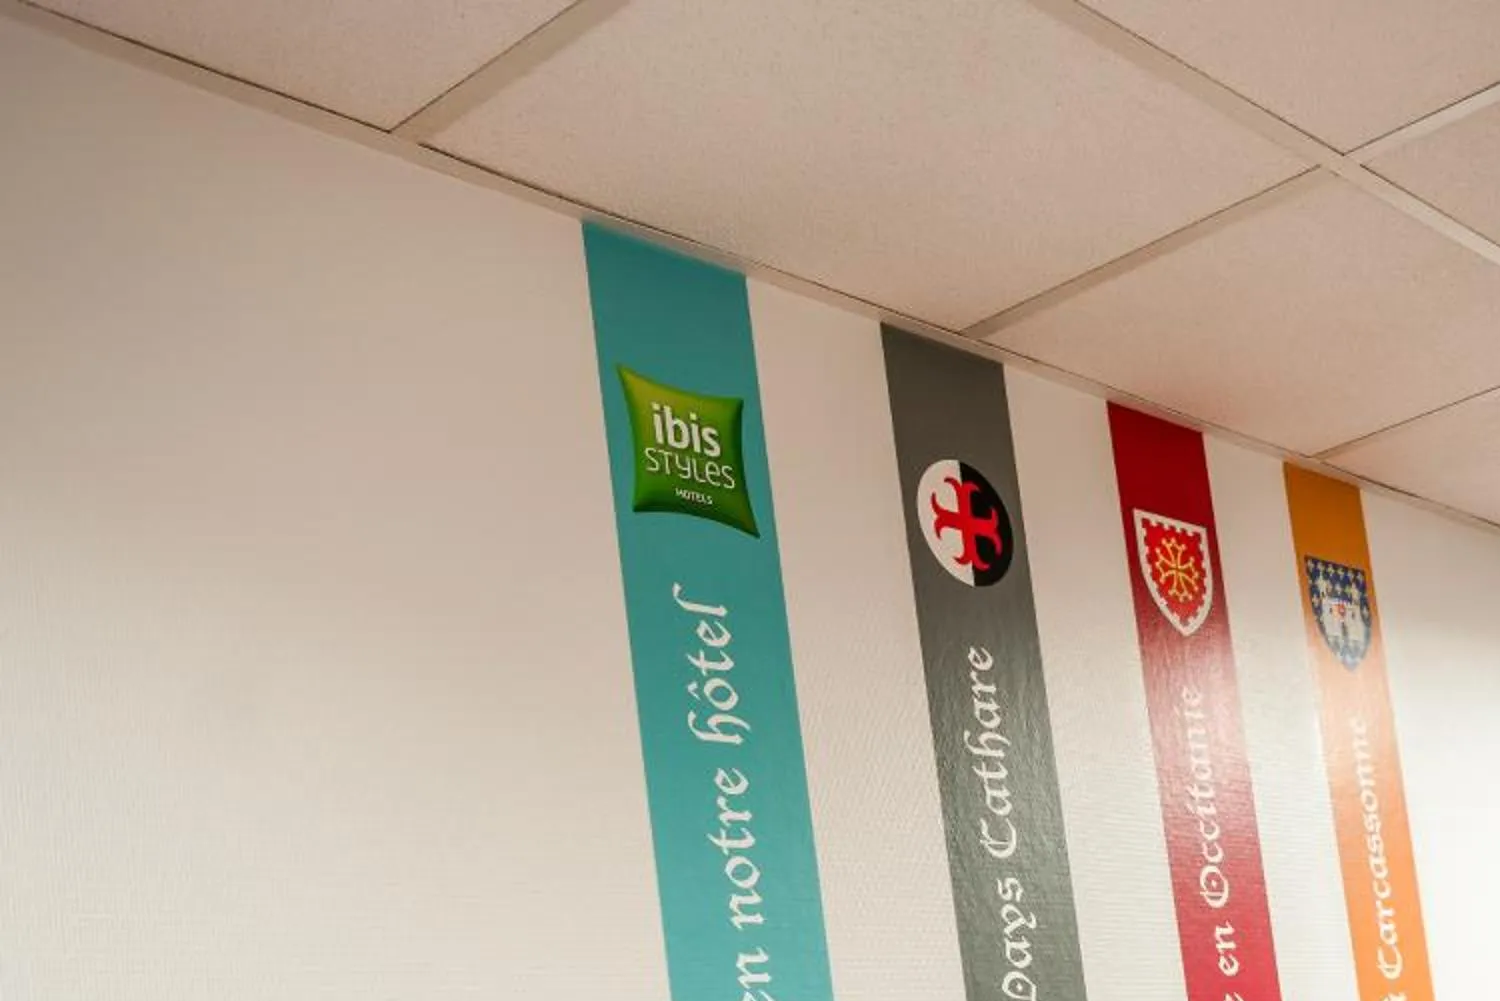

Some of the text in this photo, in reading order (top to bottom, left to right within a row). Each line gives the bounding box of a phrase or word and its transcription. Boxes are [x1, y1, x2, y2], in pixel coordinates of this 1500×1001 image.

[651, 401, 721, 458] ibis
[673, 582, 751, 745] hôtel
[964, 645, 1018, 859] Cathare
[1175, 685, 1229, 909] Occitanie
[708, 767, 767, 929] notre
[1350, 710, 1403, 980] Carcassonne
[1214, 920, 1240, 977] en
